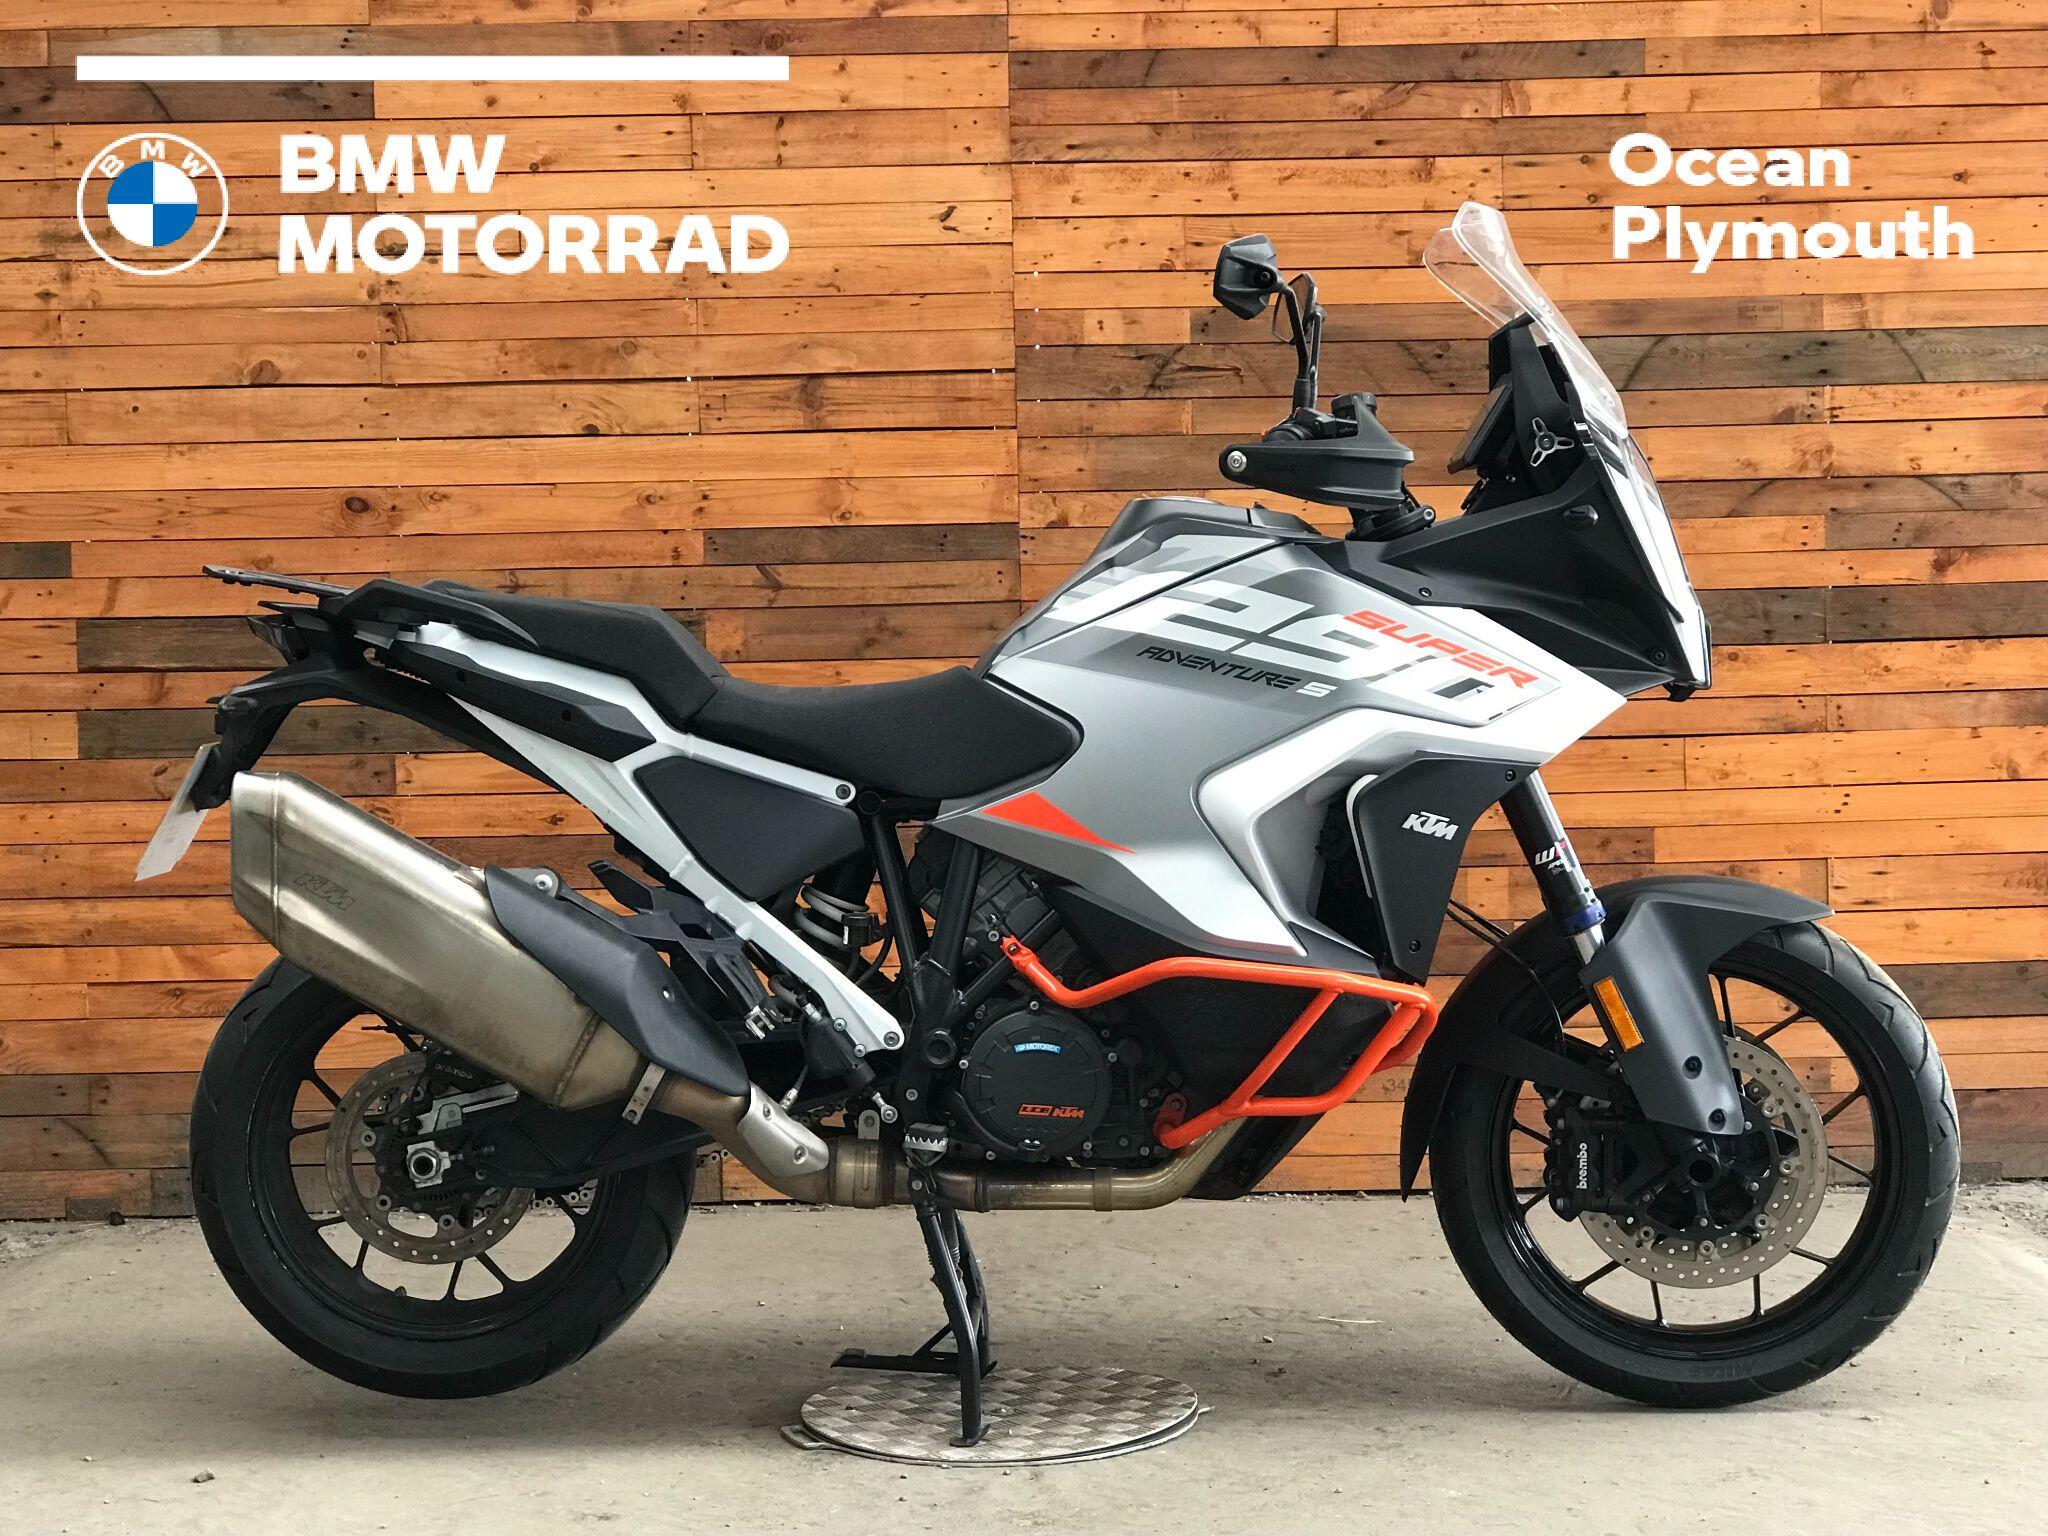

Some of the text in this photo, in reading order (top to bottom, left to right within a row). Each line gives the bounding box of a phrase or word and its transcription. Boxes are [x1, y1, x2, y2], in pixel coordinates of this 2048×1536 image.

[1343, 610, 1540, 689] SUPER
[1136, 645, 1338, 698] ADVENTURE S
[1401, 811, 1459, 841] KTM
[294, 872, 356, 911] KTM
[1052, 1106, 1085, 1118] KTM
[1576, 1142, 1588, 1190] brembo
